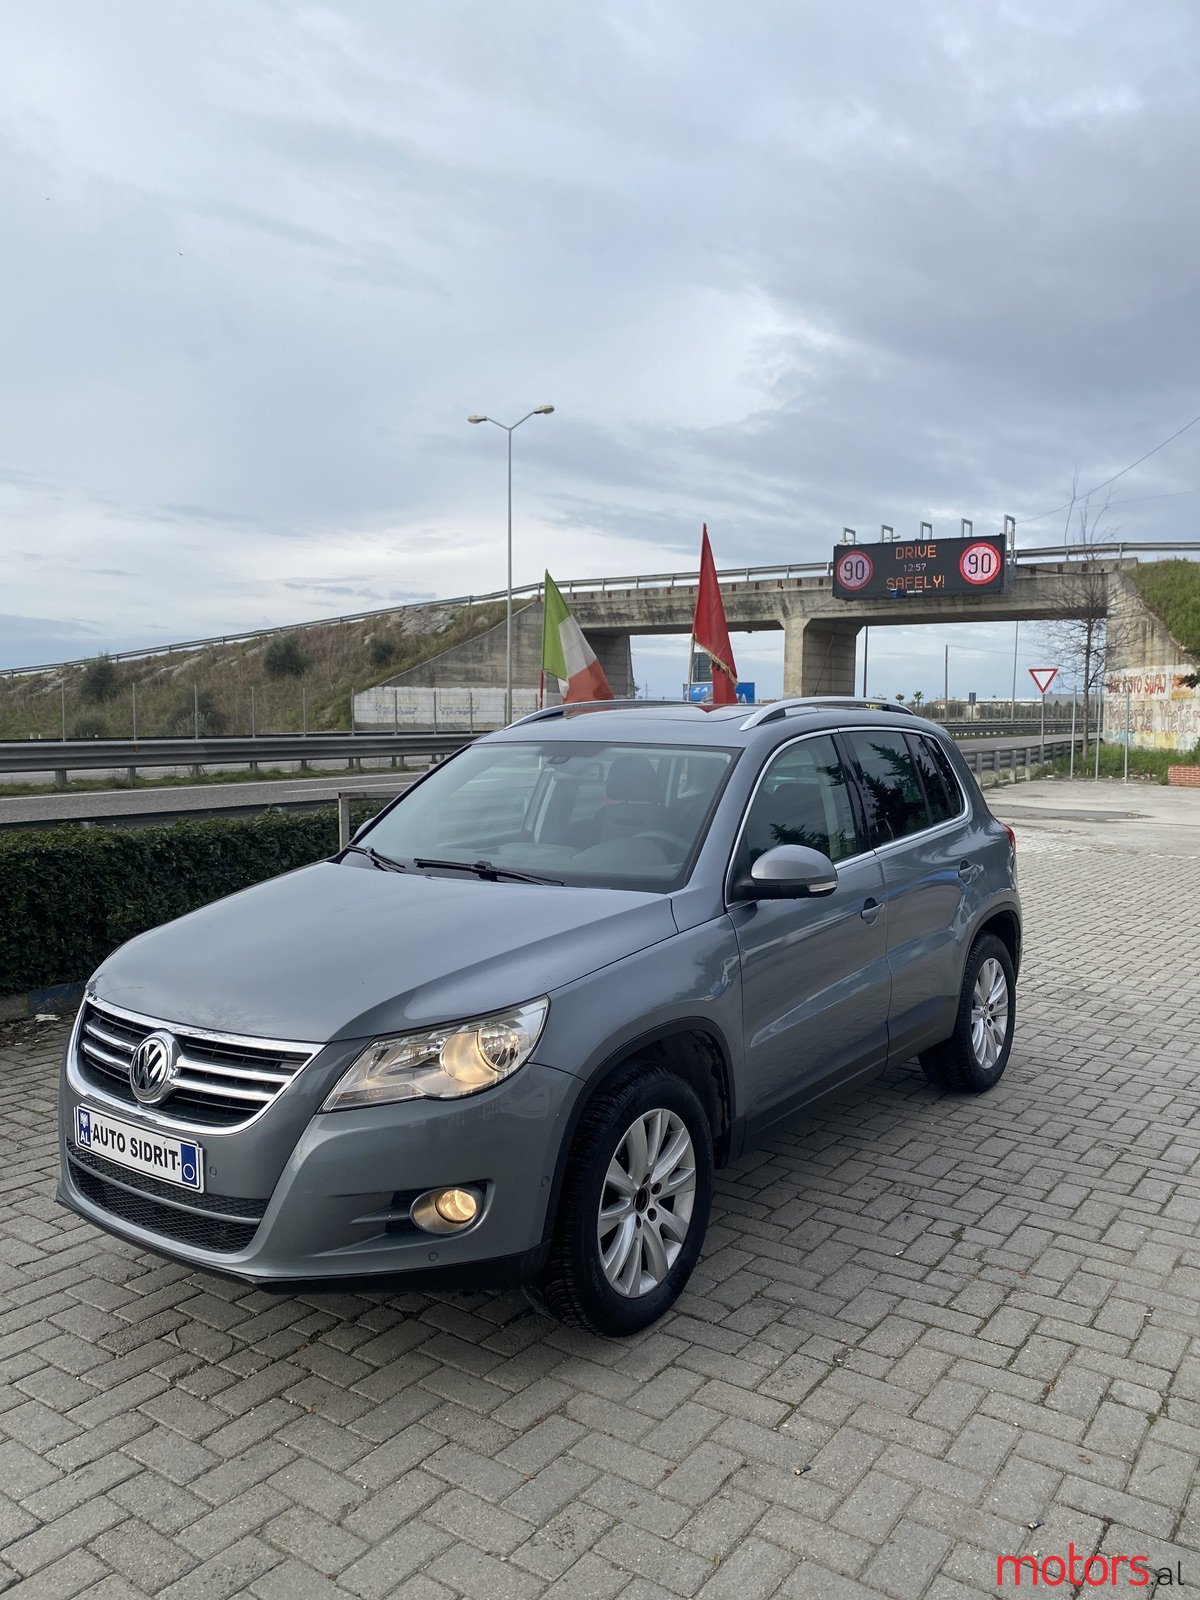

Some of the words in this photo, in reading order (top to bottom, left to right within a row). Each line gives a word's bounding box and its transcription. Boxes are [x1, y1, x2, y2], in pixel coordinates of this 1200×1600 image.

[895, 544, 937, 560] DRIVE
[844, 560, 865, 581] 90
[904, 563, 927, 572] 12:57
[968, 553, 992, 575] 90
[886, 575, 945, 590] SAFELY!
[80, 1130, 91, 1145] AL
[92, 1123, 126, 1153] AUTO
[130, 1137, 179, 1171] SIDRIT
